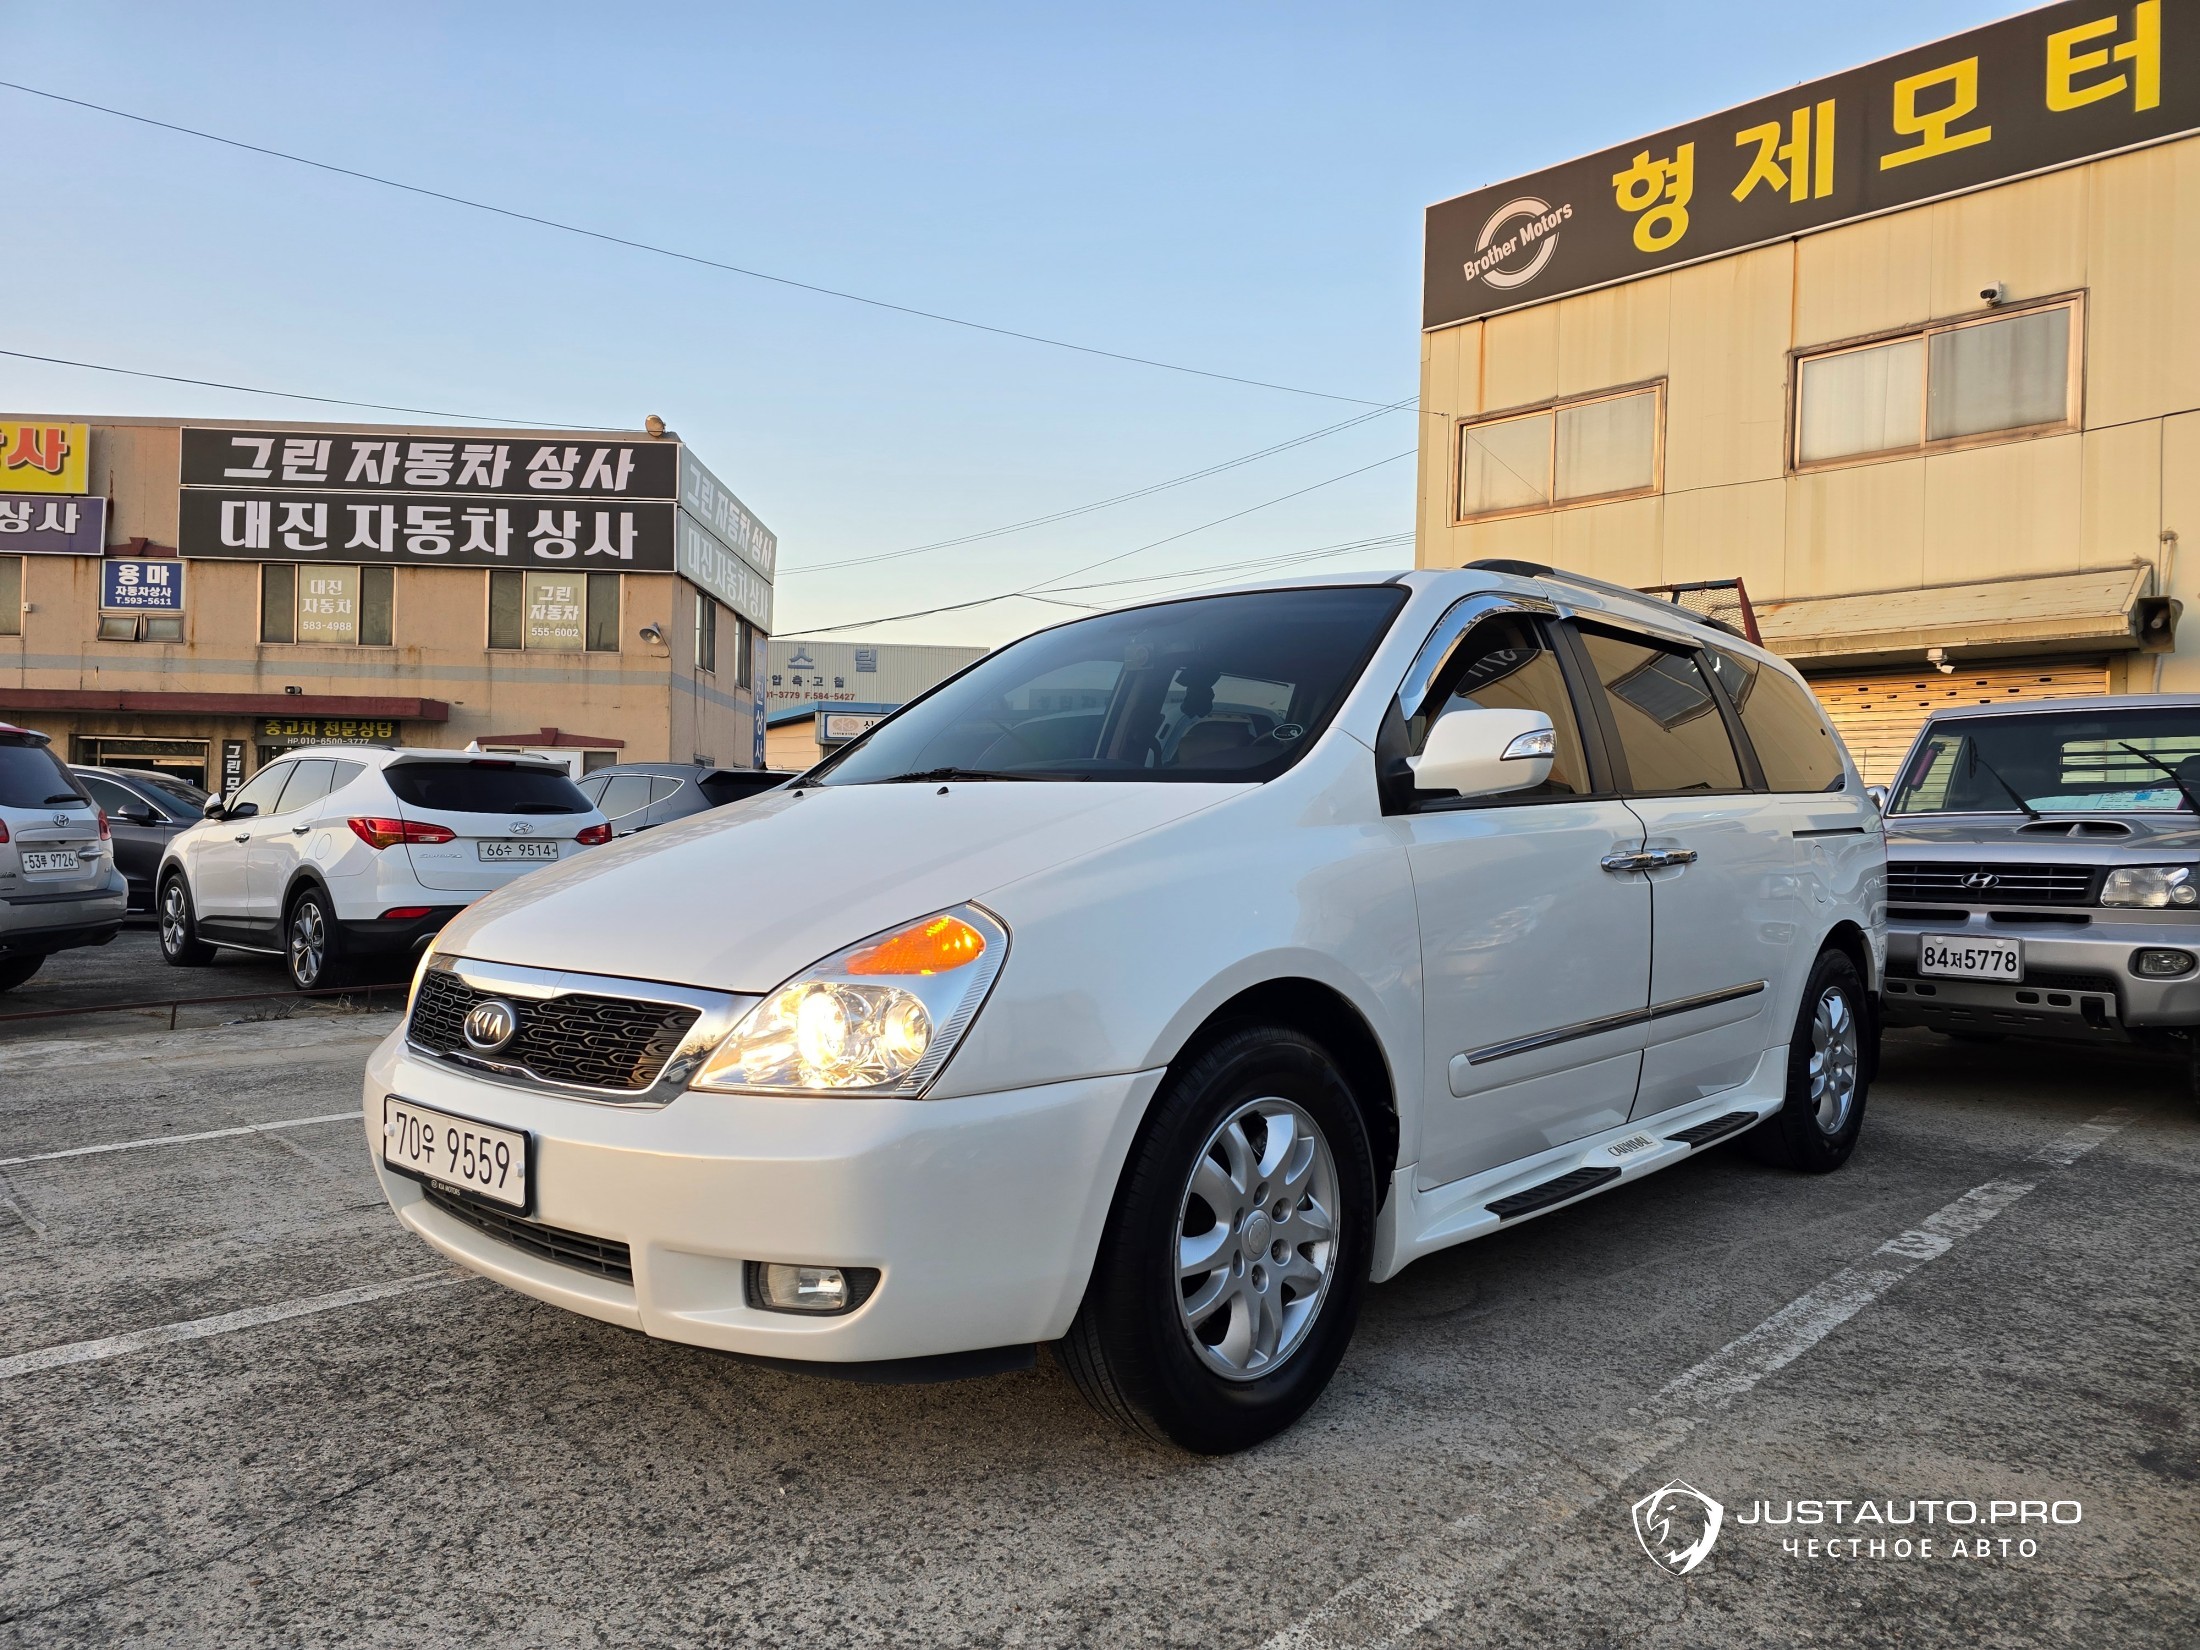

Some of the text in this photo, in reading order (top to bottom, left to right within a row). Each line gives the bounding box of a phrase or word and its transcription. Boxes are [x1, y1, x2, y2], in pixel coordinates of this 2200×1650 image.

[1463, 202, 1573, 282] Brother Motors
[0, 426, 70, 475] 사
[223, 436, 636, 492] 그린 자동차 상사
[687, 462, 773, 572] 그린 자동차 상사
[220, 500, 639, 561] 대진 자동차 상사
[687, 526, 769, 626] 대진 자동차 상사
[115, 586, 172, 597] 자동차상사
[310, 579, 343, 595] 대진
[538, 586, 572, 602] 그린
[115, 597, 172, 605] T.593-5611
[302, 598, 352, 614] 자동차
[529, 604, 579, 621] 자동차
[303, 621, 352, 631] 583-4988
[531, 627, 579, 637] 555-6002
[804, 692, 855, 701] F.584-5427
[265, 719, 395, 738] 중고차 전문상담
[50, 850, 74, 868] 9726
[487, 844, 552, 857] 66수 9514
[471, 1010, 503, 1041] KIA
[396, 1111, 510, 1189] 70우 9559
[1607, 1135, 1654, 1157] CARNIVAL
